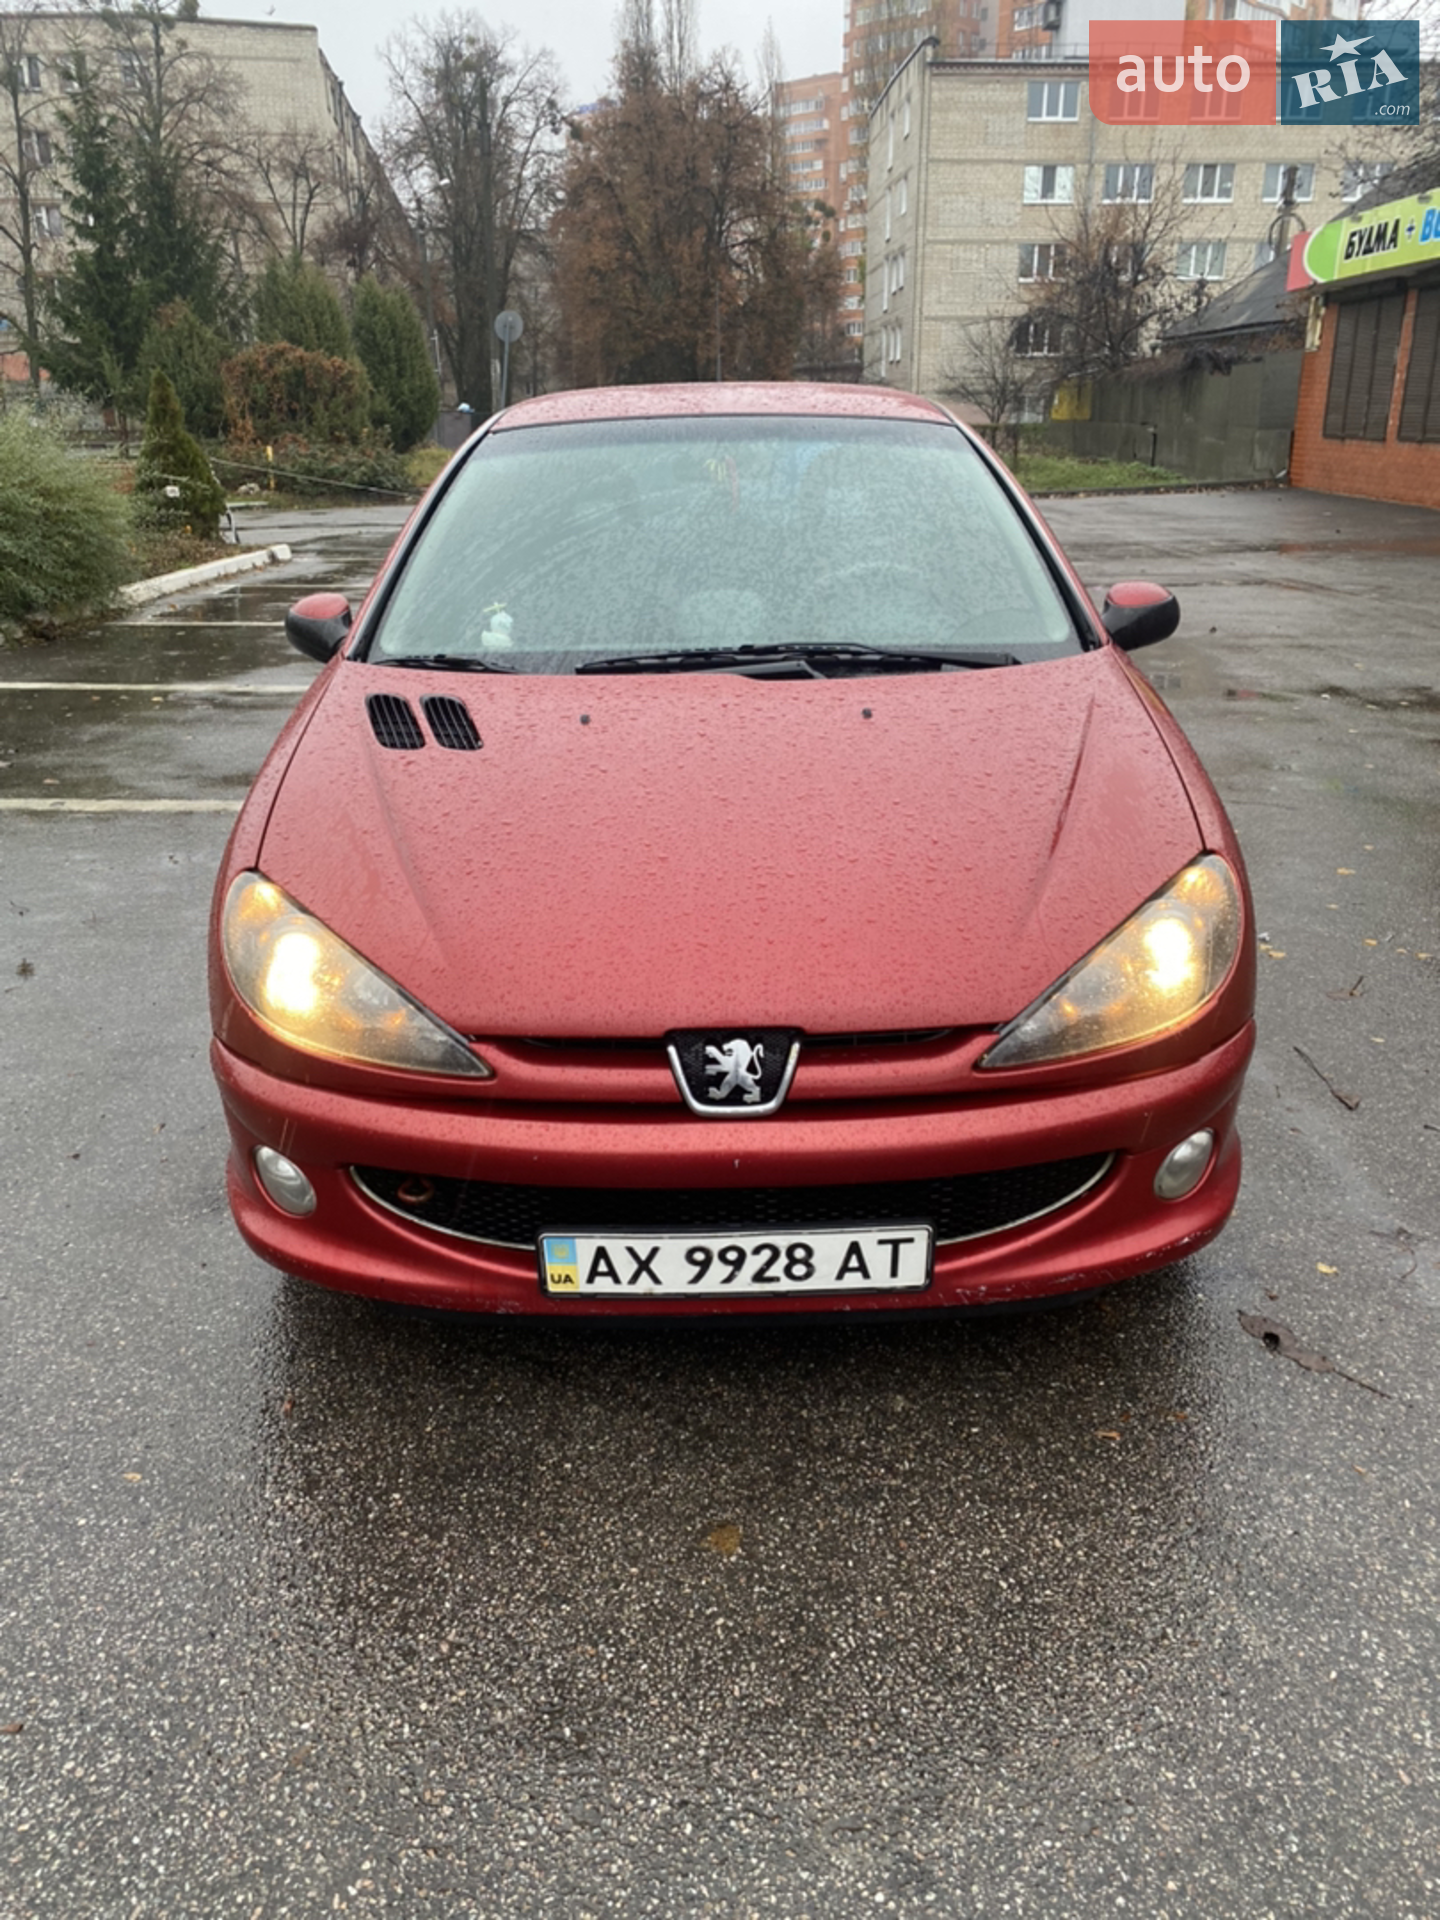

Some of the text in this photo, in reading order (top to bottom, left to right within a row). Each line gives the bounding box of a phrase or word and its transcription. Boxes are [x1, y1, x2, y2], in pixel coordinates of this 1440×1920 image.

[1344, 218, 1400, 260] БУДМА
[550, 1273, 575, 1284] UA
[585, 1237, 915, 1285] AX 9928 AT
